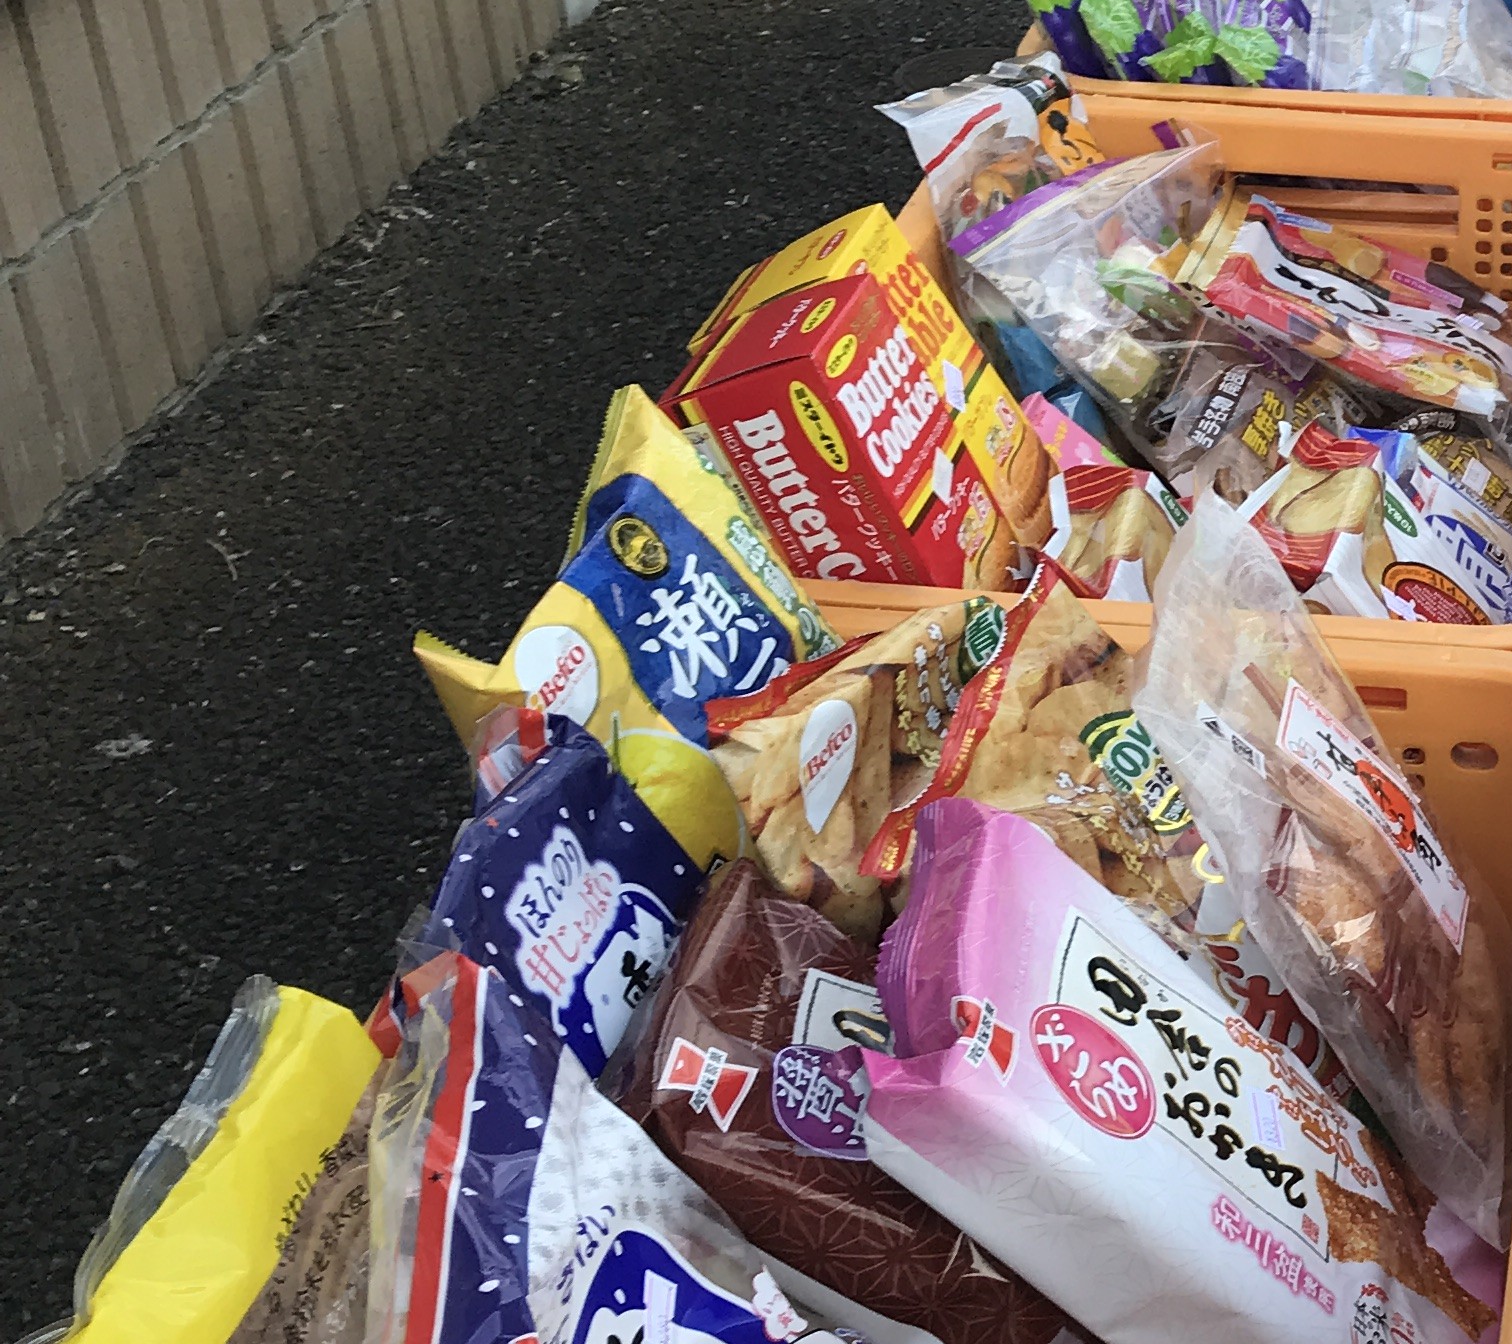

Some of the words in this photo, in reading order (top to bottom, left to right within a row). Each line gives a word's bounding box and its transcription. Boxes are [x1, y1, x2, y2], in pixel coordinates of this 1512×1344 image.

[836, 324, 918, 439] Butter
[867, 370, 940, 478] Cookies
[718, 424, 745, 462] HIGH
[737, 458, 777, 518] QUALITY
[770, 516, 806, 569] BUTTER
[732, 409, 841, 555] Butter
[832, 476, 900, 584] バタークッキー
[536, 643, 588, 712] Befco
[803, 720, 854, 784] Befco
[515, 831, 584, 940] ほんのり
[525, 868, 618, 998] 甘じょっぱい
